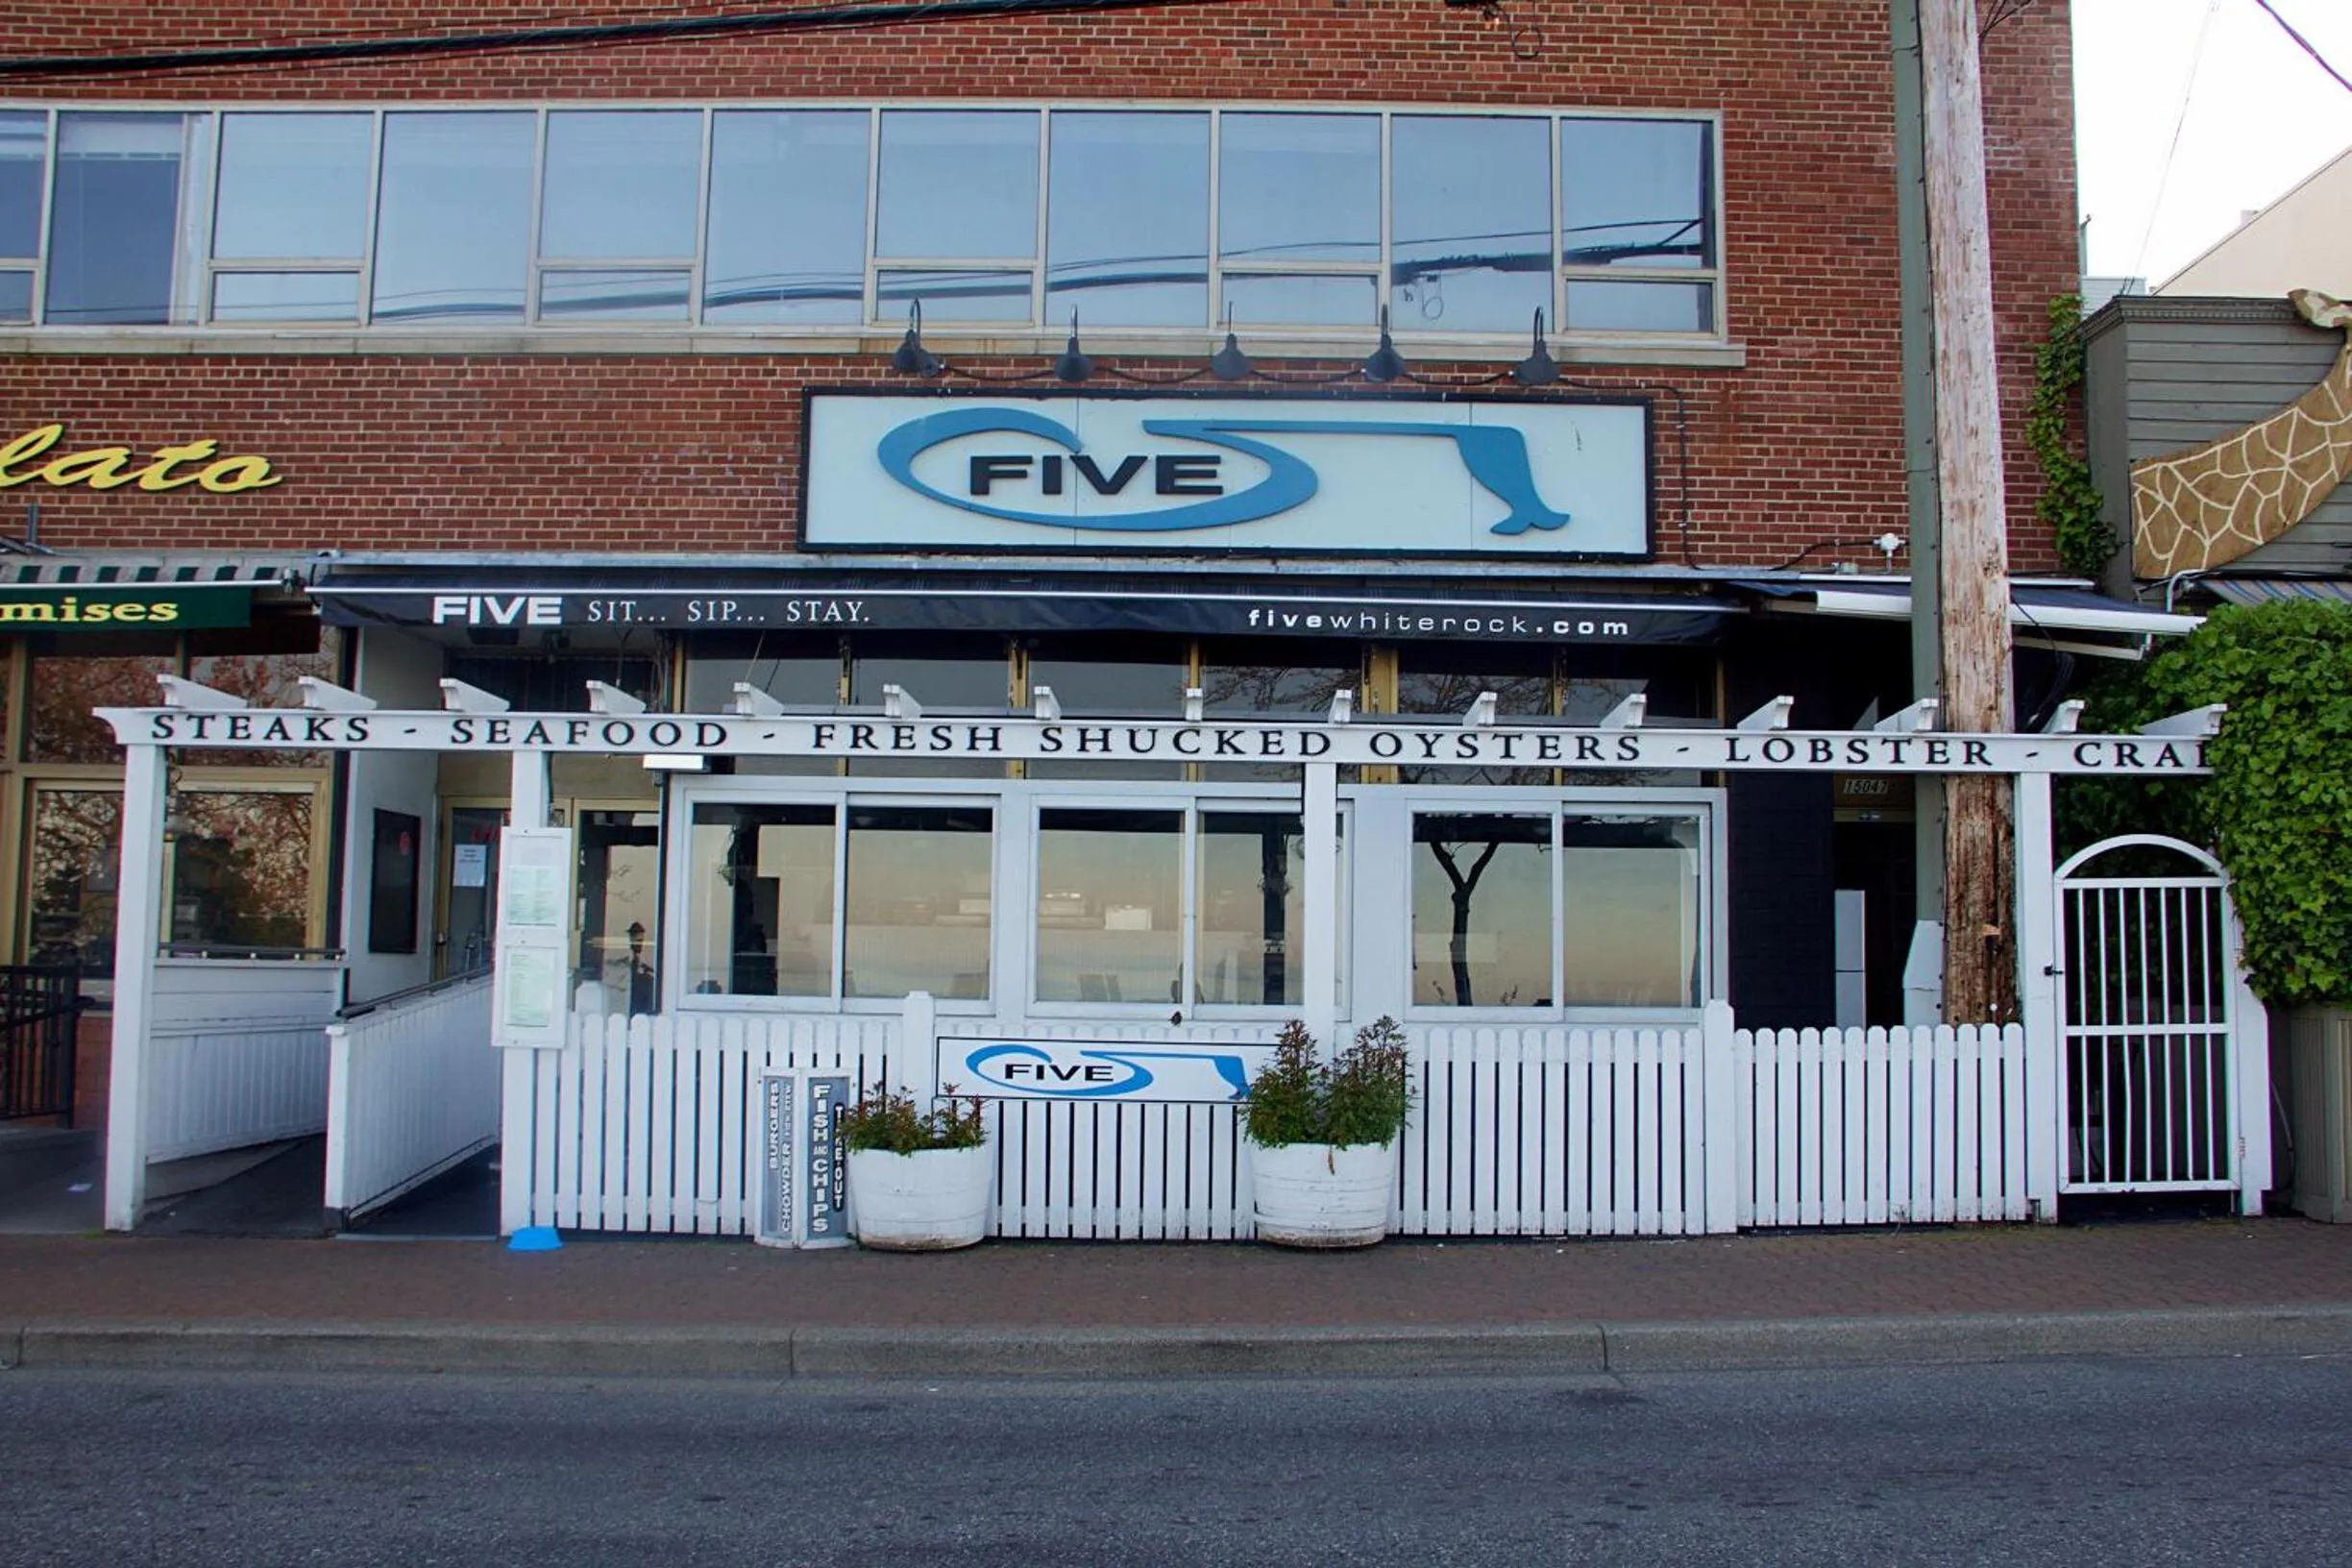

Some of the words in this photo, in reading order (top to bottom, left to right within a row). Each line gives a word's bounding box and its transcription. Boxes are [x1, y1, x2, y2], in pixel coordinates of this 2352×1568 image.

[968, 453, 1225, 497] FIVE
[432, 595, 563, 625] FIVE
[587, 600, 667, 624] SIT...
[687, 600, 766, 624] SIP...
[786, 600, 870, 624] STAY.
[1248, 608, 1629, 636] fivewhiterock.com
[151, 713, 371, 743] STEAKS
[451, 717, 727, 747] SEAFOOD
[811, 723, 1003, 752] FRESH
[1040, 725, 1332, 757] SHUCKED
[1368, 731, 1642, 761] OYSTERS
[1725, 737, 1994, 767] LOBSTER
[1003, 1064, 1115, 1082] FIVE
[769, 1082, 780, 1170] BURGERS
[812, 1084, 831, 1142] FISH
[781, 1142, 793, 1233] CHOWDER
[812, 1159, 829, 1233] CHIPS
